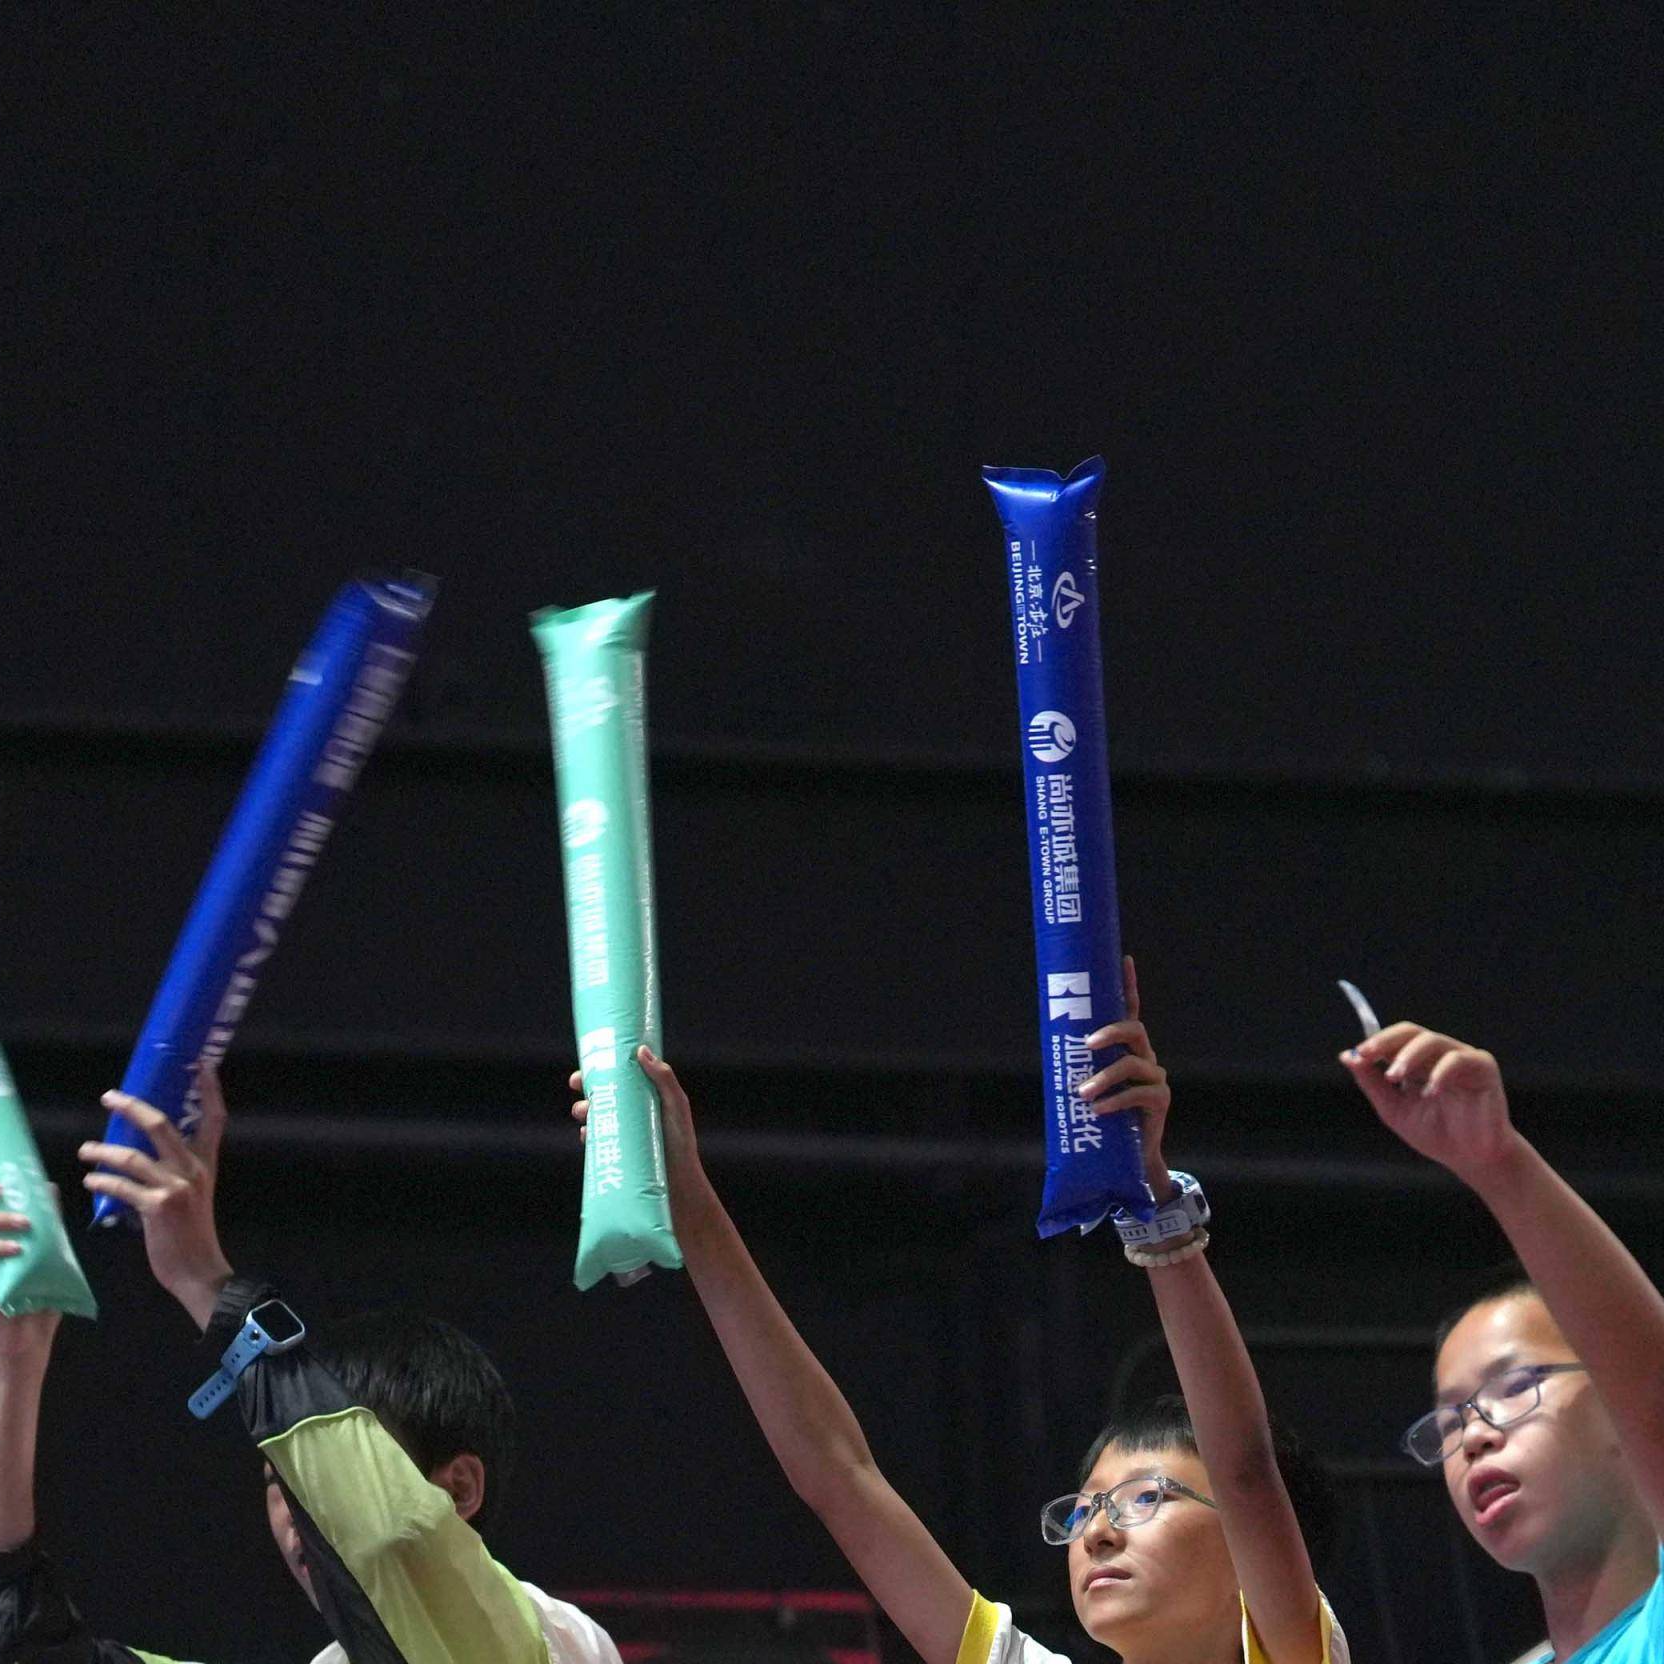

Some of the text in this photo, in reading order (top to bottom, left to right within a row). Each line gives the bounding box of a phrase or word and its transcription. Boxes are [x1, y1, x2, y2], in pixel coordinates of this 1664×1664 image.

[1036, 775, 1055, 924] SHANG E-TOWN GROUP
[1048, 773, 1083, 924] 尚亦城集团
[592, 1081, 625, 1196] 加速进化
[1051, 1035, 1070, 1154] BOOSTER ROBOTICS
